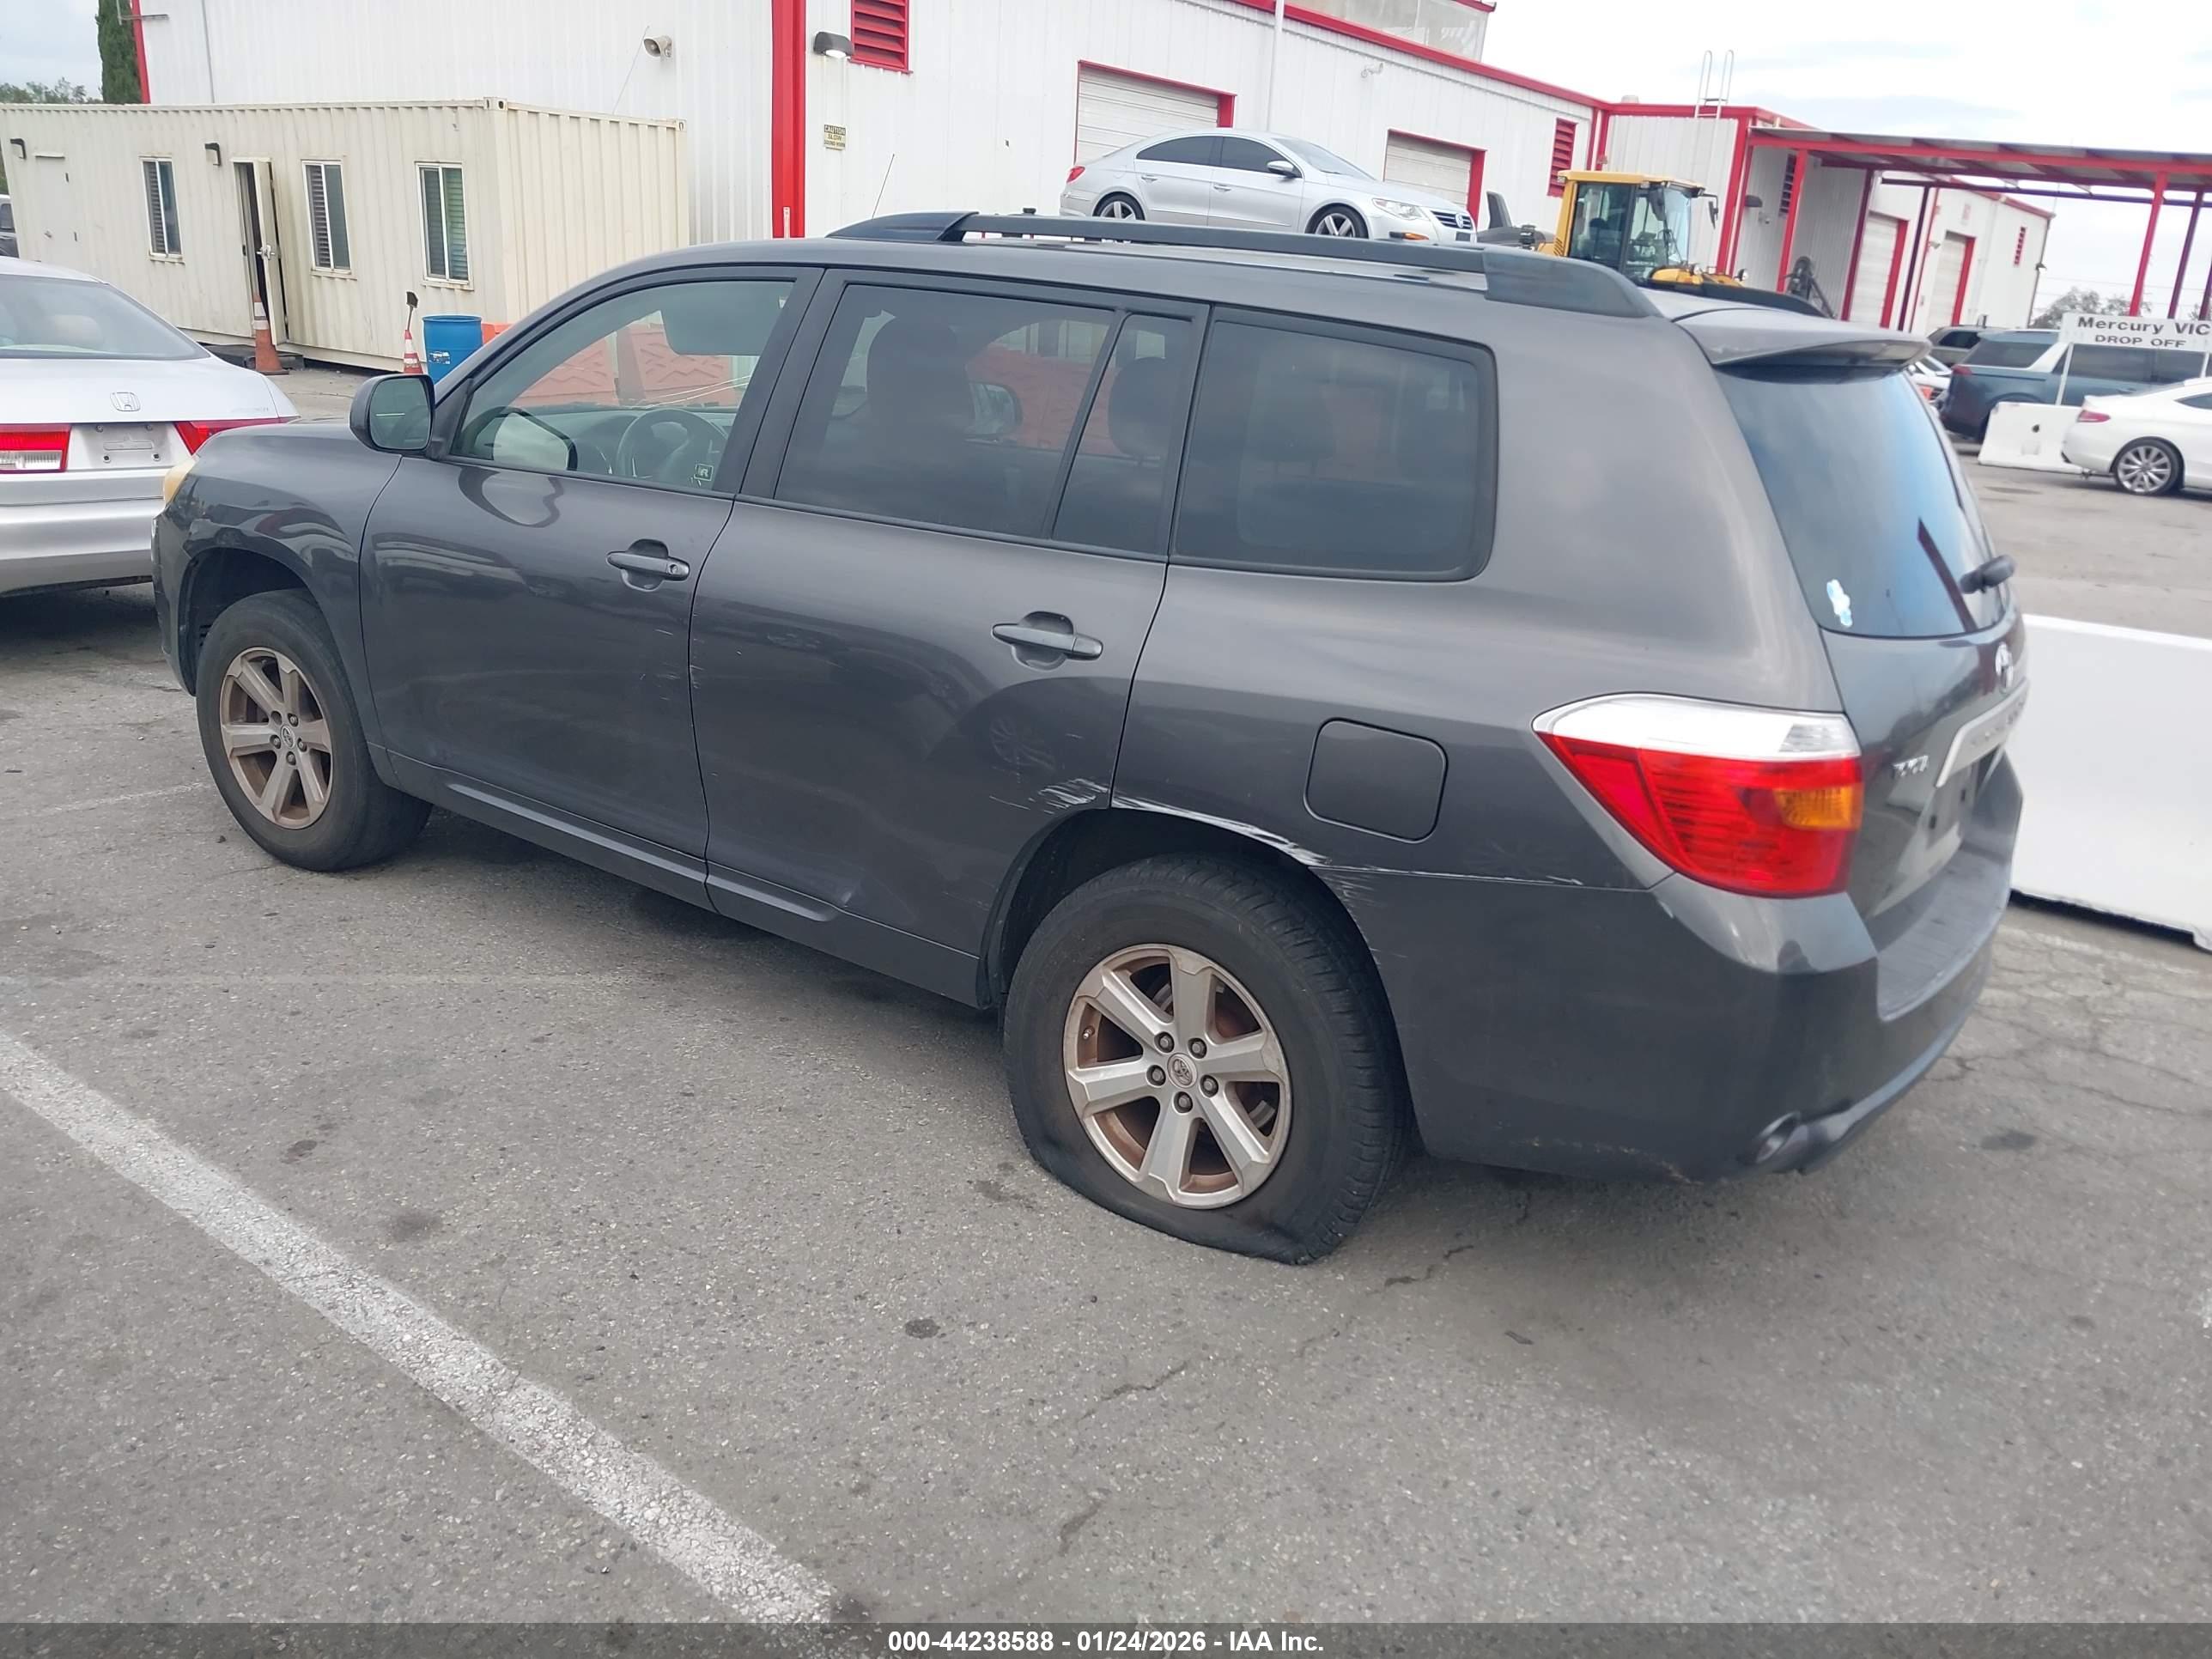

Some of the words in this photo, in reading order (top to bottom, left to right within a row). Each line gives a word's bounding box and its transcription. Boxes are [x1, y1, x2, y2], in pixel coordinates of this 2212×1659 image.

[824, 125, 846, 135] CAUTION
[2078, 317, 2164, 334] Mercury
[2094, 334, 2143, 345] DROP
[2150, 338, 2187, 348] OFF
